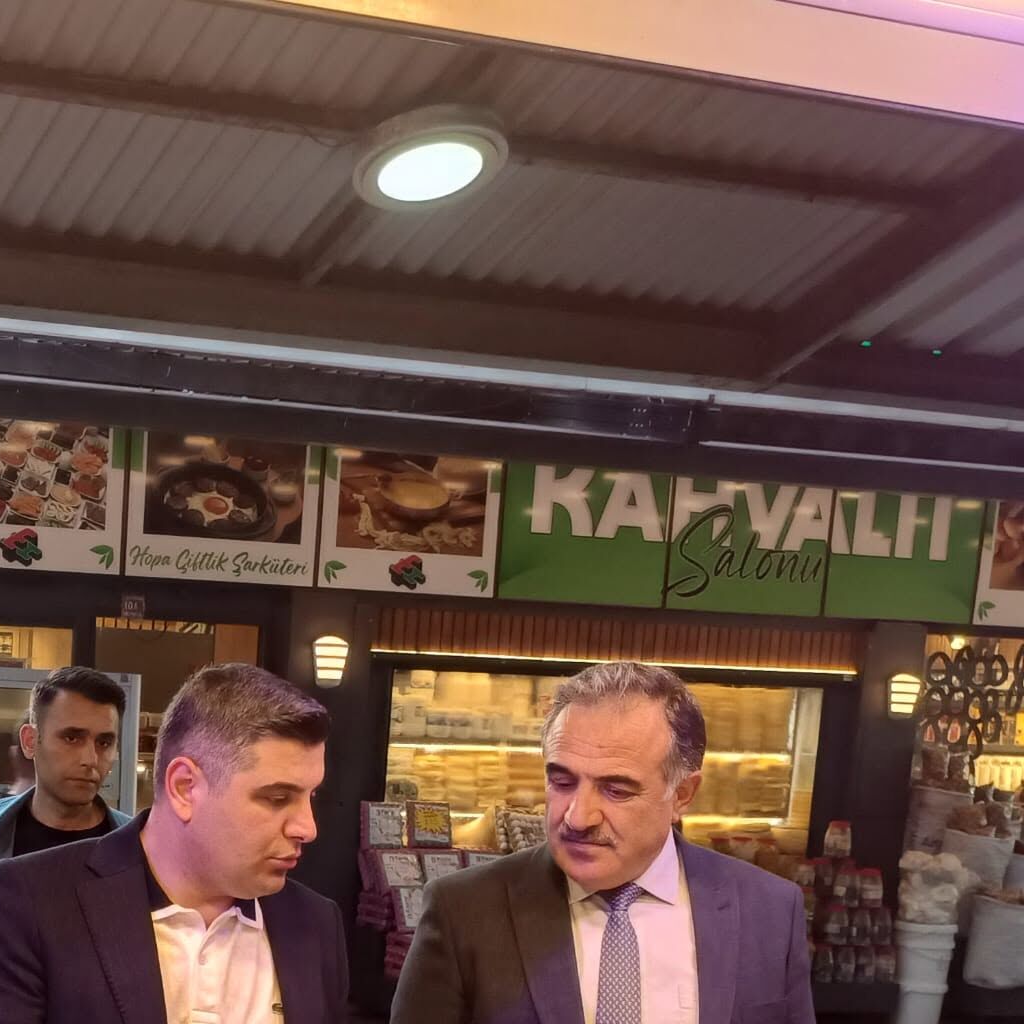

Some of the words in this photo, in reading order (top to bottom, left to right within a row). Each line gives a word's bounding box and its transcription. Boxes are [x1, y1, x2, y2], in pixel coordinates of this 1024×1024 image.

[129, 545, 171, 570] Hopa
[175, 549, 229, 574] Çiftlik
[232, 552, 308, 577] Şarküteri
[664, 504, 822, 597] Salonu
